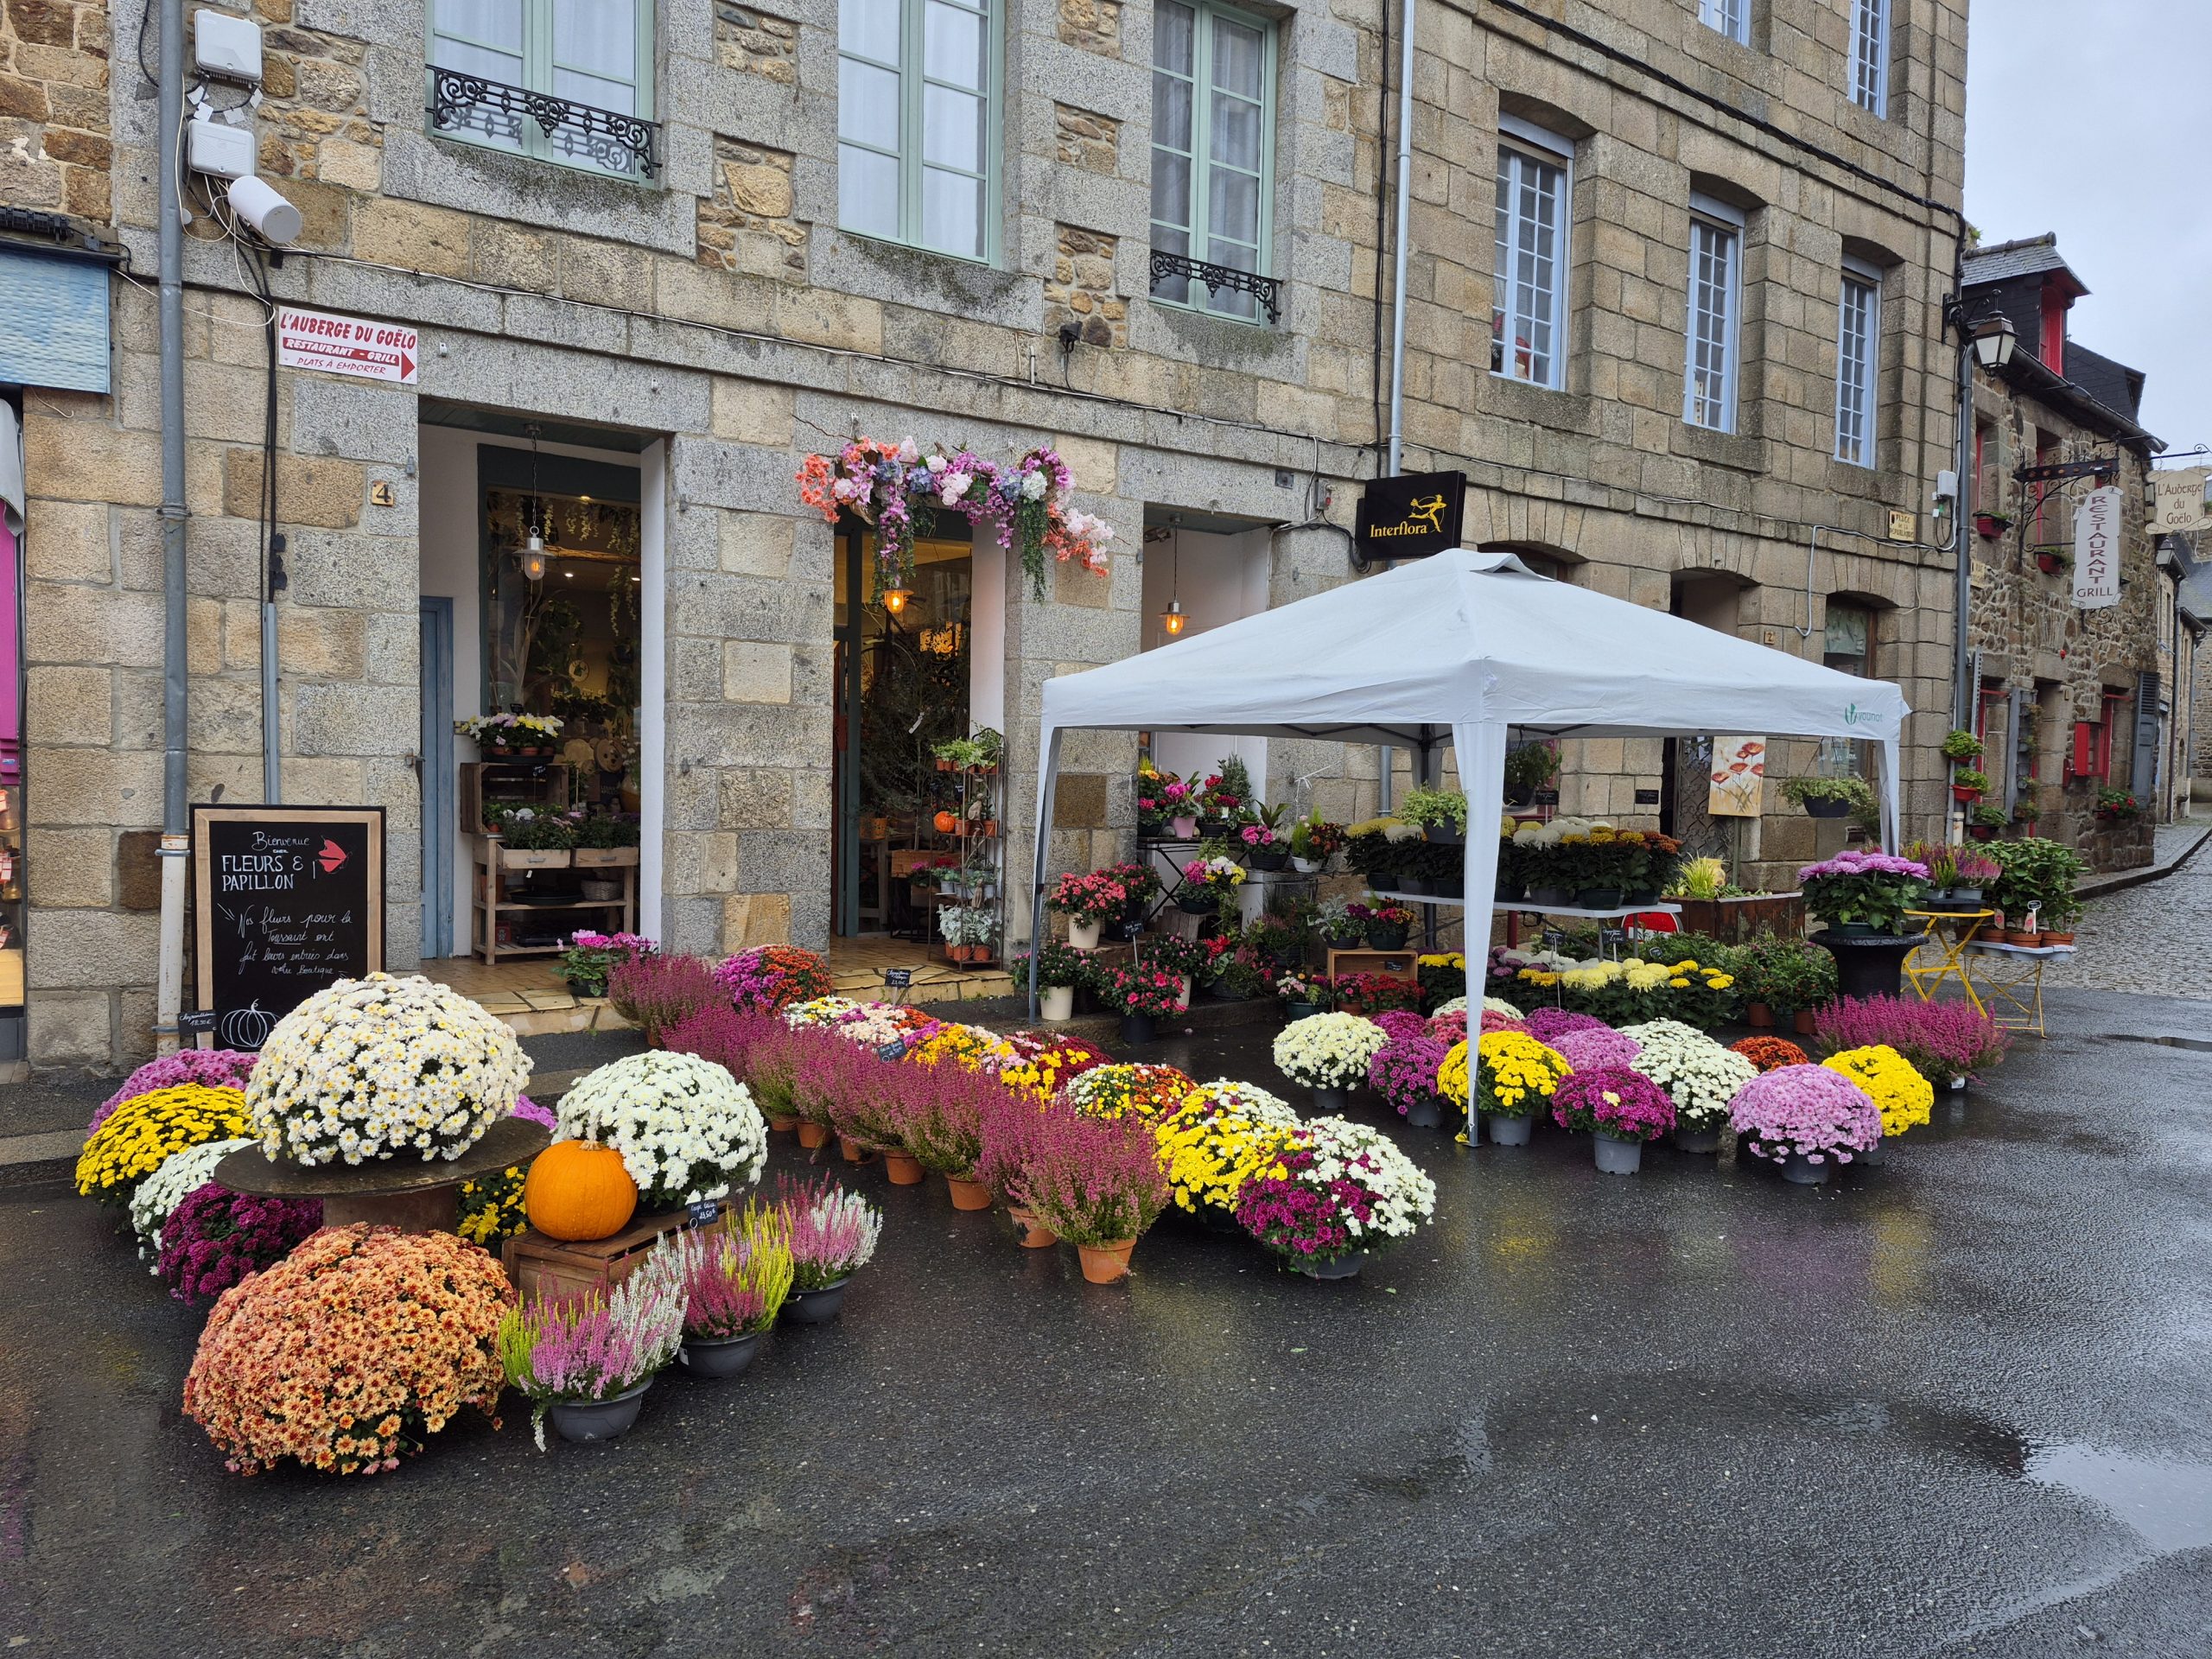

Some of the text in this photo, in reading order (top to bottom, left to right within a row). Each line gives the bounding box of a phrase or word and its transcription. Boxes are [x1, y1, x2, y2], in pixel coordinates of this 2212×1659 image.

[280, 313, 416, 350] L'AUBERGE DU GOËLO
[286, 339, 354, 358] RESTAURANT
[367, 353, 397, 364] GRILL
[297, 358, 386, 375] PLATS À EMPORTER
[376, 484, 391, 503] 4
[2174, 498, 2185, 509] du
[2166, 512, 2192, 524] Goëlo
[1370, 520, 1427, 537] Interflora
[2087, 496, 2108, 584] RESTAURANT
[2076, 587, 2113, 598] GRILL
[251, 830, 311, 851] Bienvenue
[221, 855, 283, 873] FLEURS
[222, 874, 294, 892] PAPILLON
[238, 905, 353, 939] Nos fleurs pour la
[268, 928, 334, 943] Toussaint ont
[238, 940, 257, 975] fait
[262, 948, 285, 961] leurs
[325, 949, 348, 961] dans
